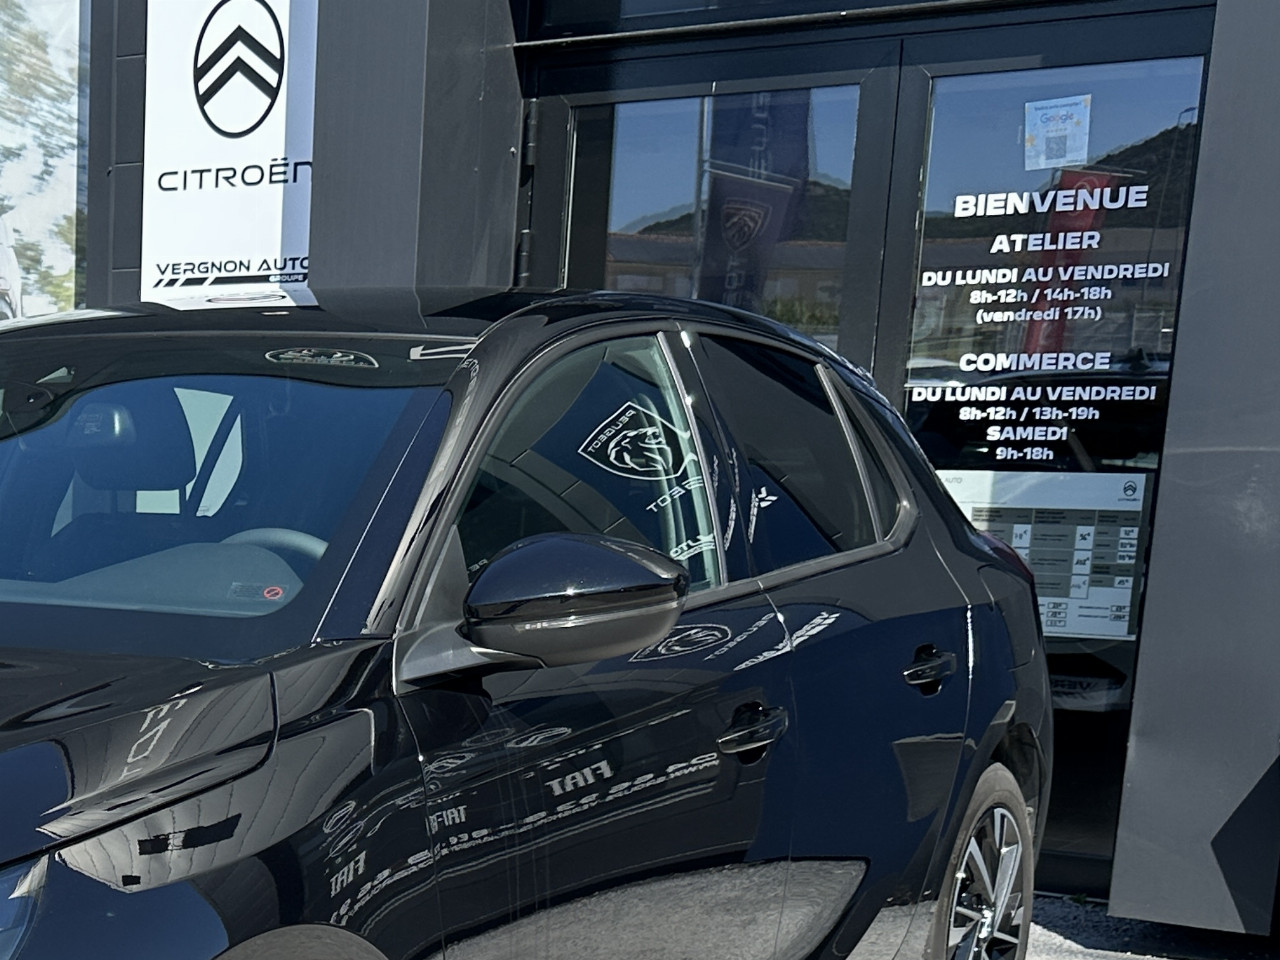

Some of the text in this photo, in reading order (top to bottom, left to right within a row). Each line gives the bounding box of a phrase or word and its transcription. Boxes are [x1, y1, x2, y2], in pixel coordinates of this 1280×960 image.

[954, 185, 1149, 218] BIENVENUE
[989, 231, 1101, 254] ATELIER
[156, 259, 250, 275] VERGNON
[921, 263, 1170, 287] DU LUNDI AU VENDREDI
[969, 289, 1027, 304] 8h-12h
[1044, 286, 1112, 302] 14h-18h
[976, 306, 1102, 325] (vendredi 17h)
[959, 352, 1111, 372] COMMERCE
[911, 386, 1157, 402] DU LUNDI AU VENDREDI
[959, 407, 1017, 421] 8h-12h
[1033, 406, 1100, 420] 13h-19h
[995, 446, 1054, 460] 9h-18h
